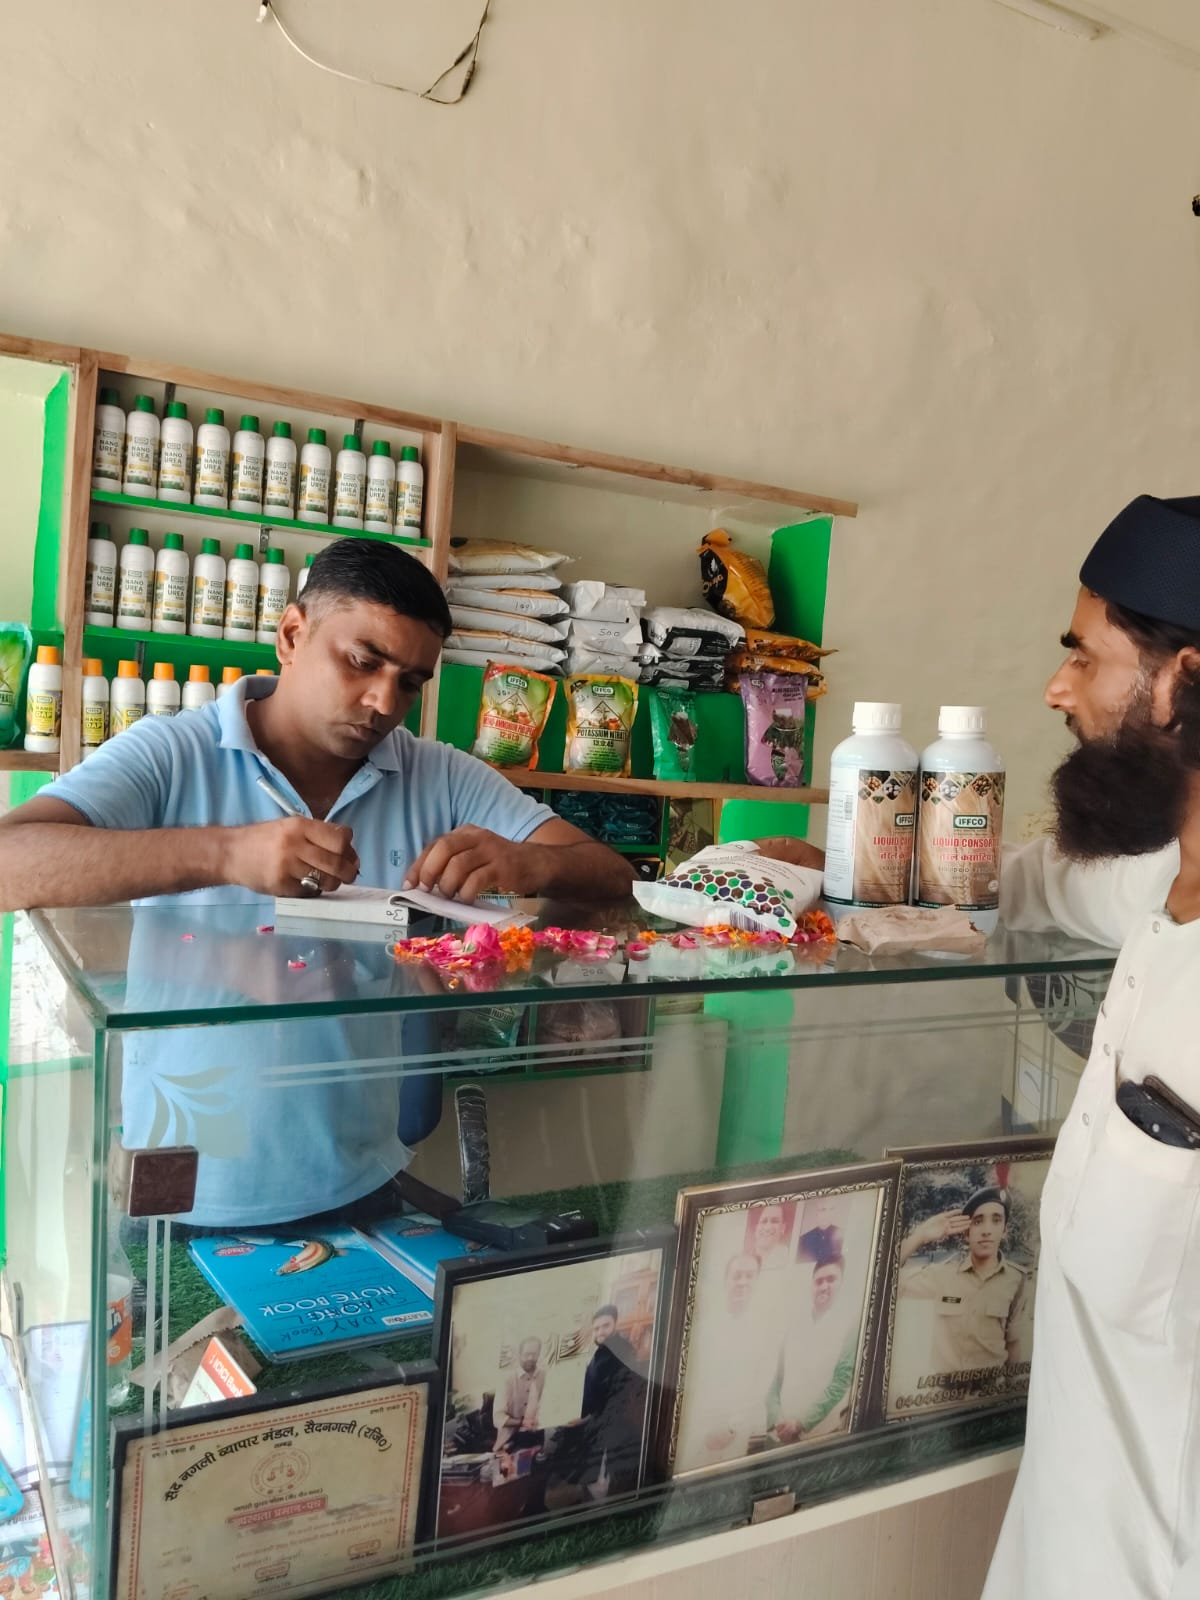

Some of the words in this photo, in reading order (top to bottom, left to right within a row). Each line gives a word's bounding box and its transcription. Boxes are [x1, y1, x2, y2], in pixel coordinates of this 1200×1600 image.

[509, 677, 526, 686] IFFCO
[35, 711, 53, 719] DAP
[576, 728, 609, 740] POTASSIUM
[958, 818, 984, 826] IFFCO
[873, 836, 899, 846] LIQUID
[932, 838, 960, 848] LIQUID
[330, 1285, 398, 1304] NOTE
[258, 1296, 328, 1317] BOOK
[308, 1302, 373, 1322] LONG
[331, 1315, 376, 1334] DAY
[212, 1357, 228, 1383] ICICI
[226, 1375, 244, 1397] Bank
[917, 1374, 947, 1390] LATE
[950, 1368, 991, 1384] TABISH
[178, 1451, 217, 1481] नगली
[218, 1435, 260, 1458] व्यापार
[262, 1427, 299, 1442] मंडल,
[304, 1420, 357, 1434] सैदनगली
